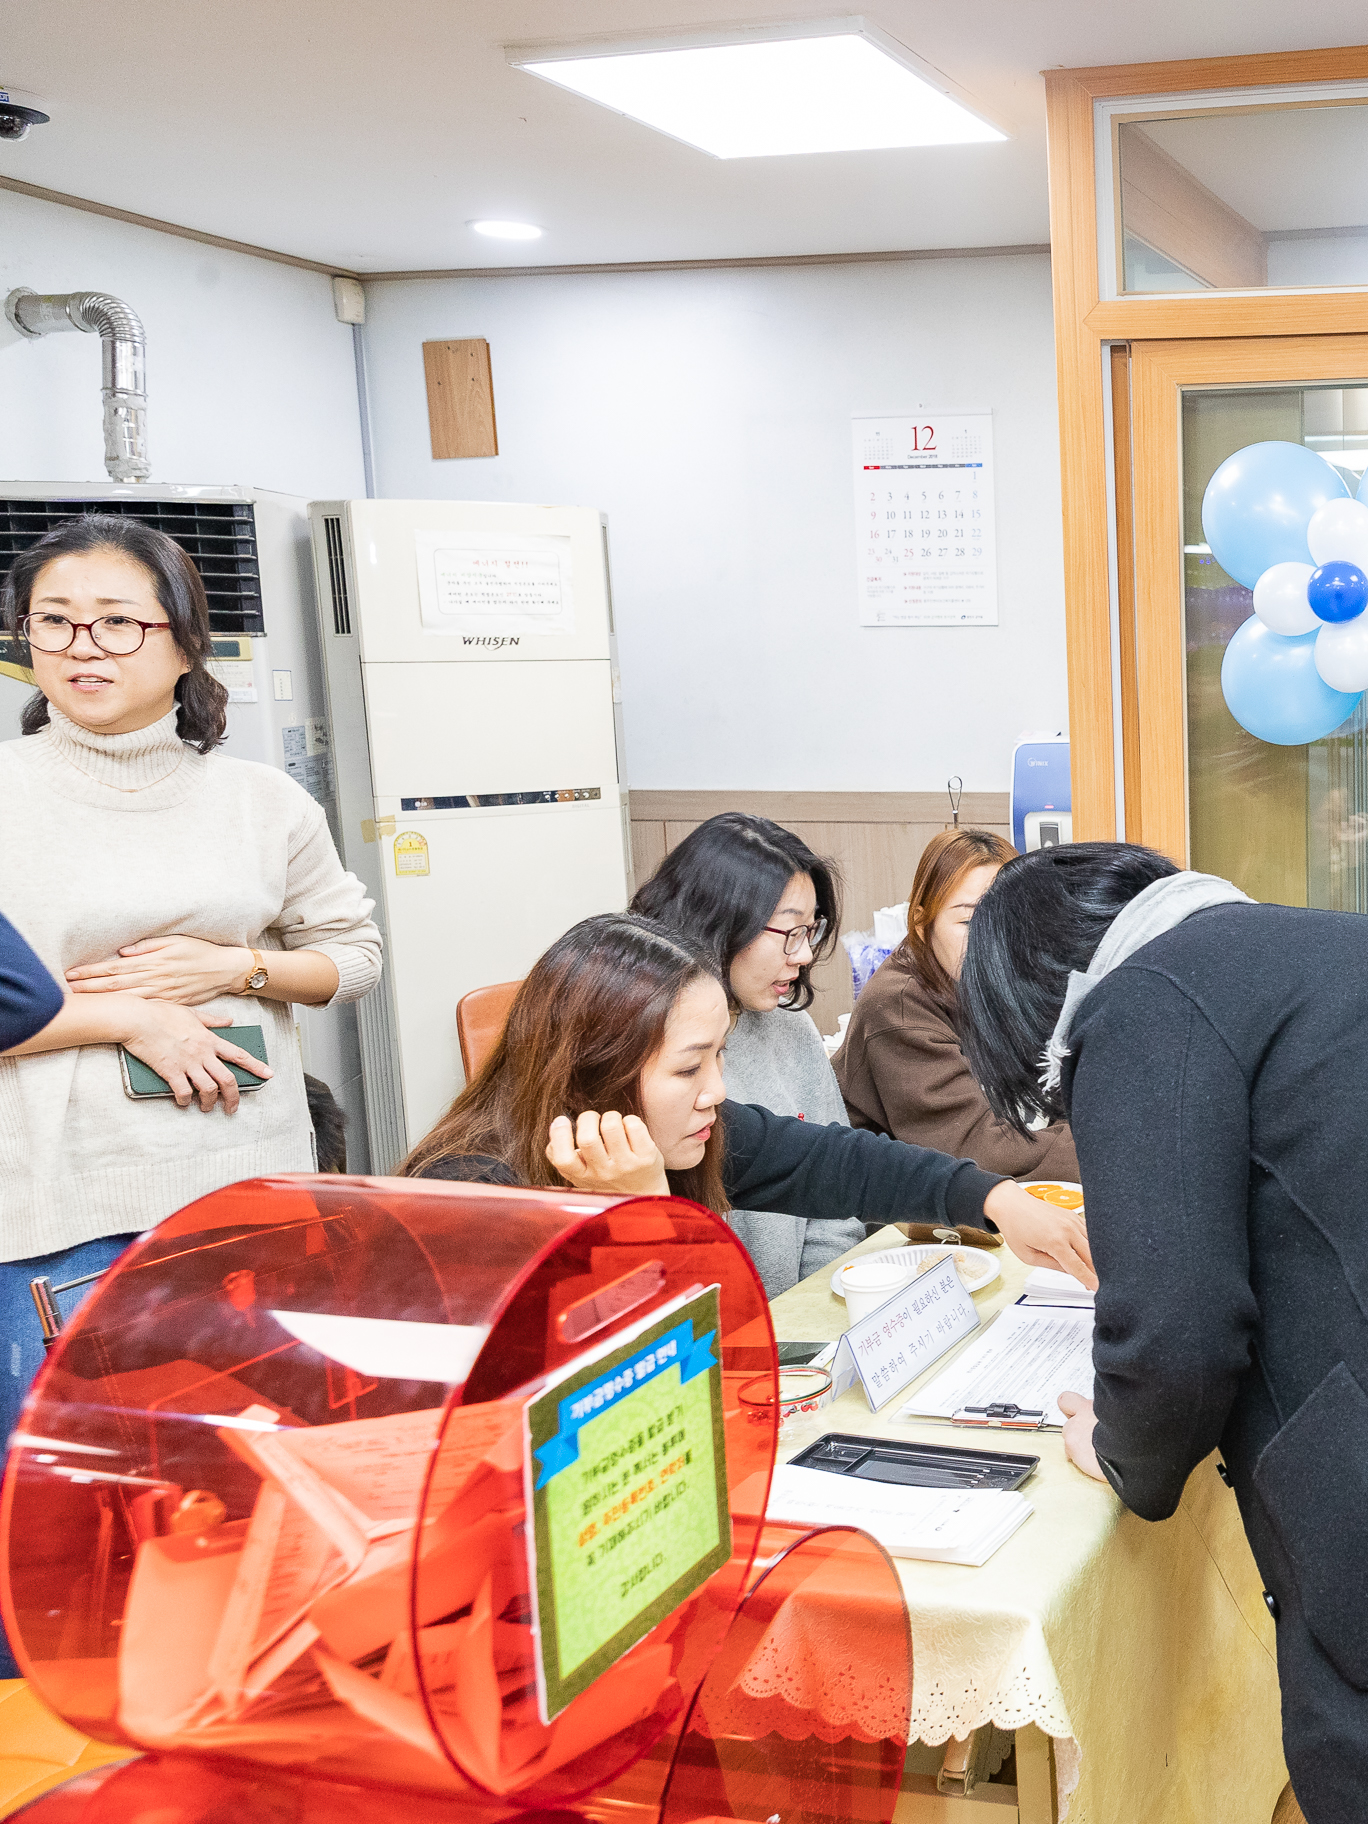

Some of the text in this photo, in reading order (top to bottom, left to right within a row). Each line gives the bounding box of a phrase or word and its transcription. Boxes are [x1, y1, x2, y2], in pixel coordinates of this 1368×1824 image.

[911, 425, 937, 451] 12
[870, 490, 978, 501] 2 3 4 5 6 7 8
[871, 509, 981, 520] 9 10 11 12 13 14 15
[870, 528, 982, 539] 16 17 18 19 20 21 22
[904, 548, 914, 557] 25
[921, 548, 931, 557] 26
[938, 548, 948, 556] 27
[955, 548, 965, 556] 28
[972, 547, 982, 556] 29
[461, 636, 520, 648] WHISEN
[857, 1275, 955, 1357] 기부금 영수증이 필요하신 분은
[871, 1303, 971, 1389] 말씀하여 주시기 바랍니다.
